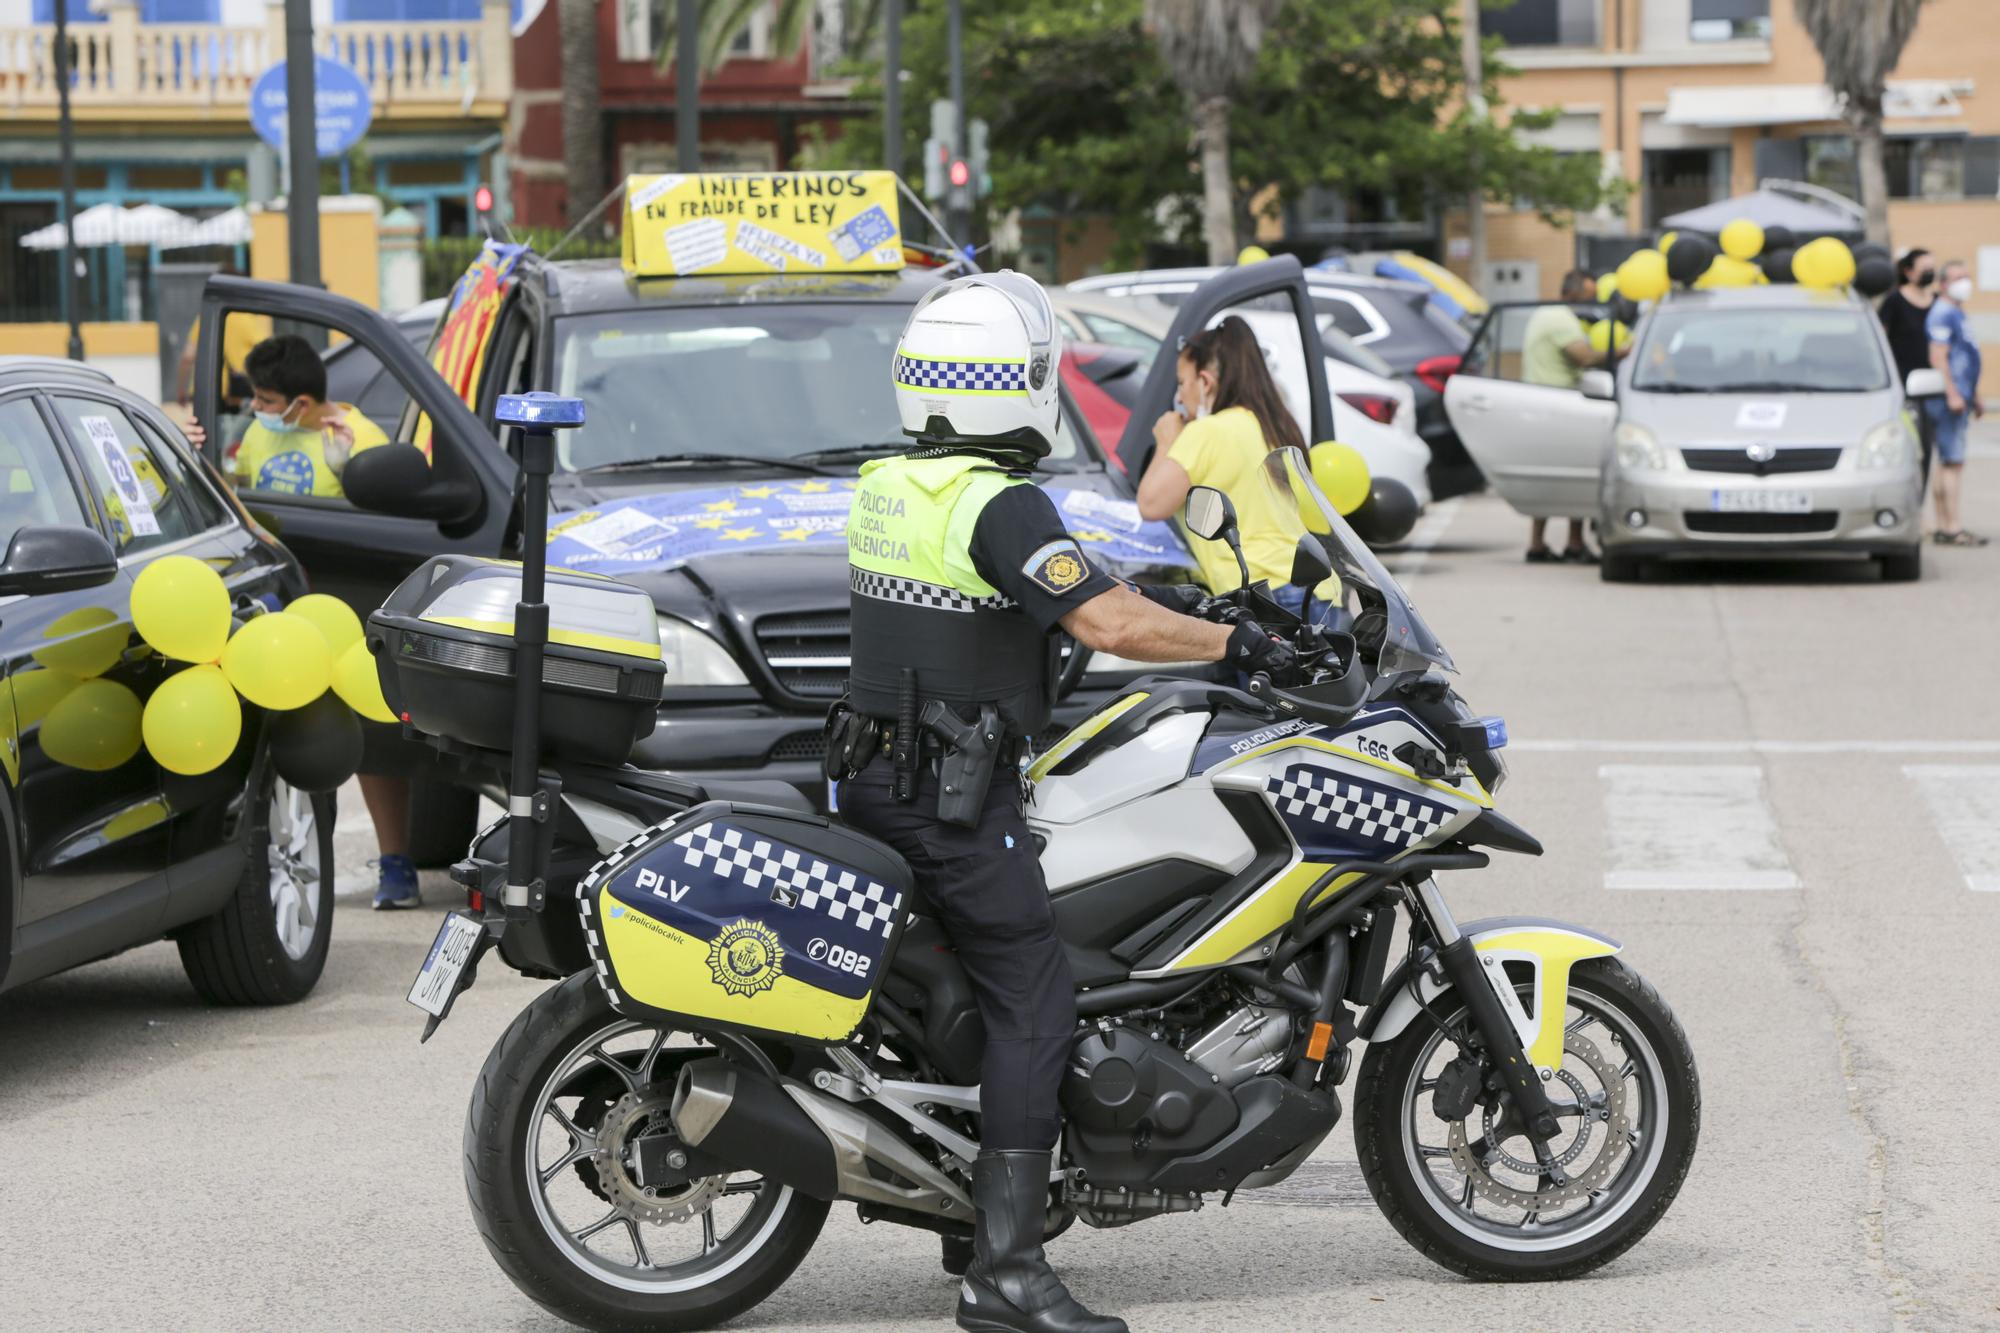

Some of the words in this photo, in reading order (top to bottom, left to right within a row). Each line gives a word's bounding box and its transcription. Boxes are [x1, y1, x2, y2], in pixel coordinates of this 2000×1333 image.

[700, 174, 867, 197] INTERINOS
[646, 205, 666, 219] EN
[681, 201, 744, 217] FRAUDE
[757, 204, 779, 218] DE
[795, 204, 836, 226] LEY
[859, 489, 905, 518] POLICIA
[861, 516, 886, 534] LOCAL
[850, 530, 911, 562] VALENCIA
[1230, 731, 1277, 754] POLICIA
[1277, 719, 1315, 736] LOCAL
[1356, 735, 1390, 761] T-66
[635, 868, 690, 903] PLV
[624, 911, 685, 945] @policialocalvlc
[442, 926, 476, 966] 4005
[725, 929, 758, 946] POLICIA
[760, 935, 774, 963] LOCAL
[827, 944, 871, 978] 092
[421, 966, 452, 1005] JYK
